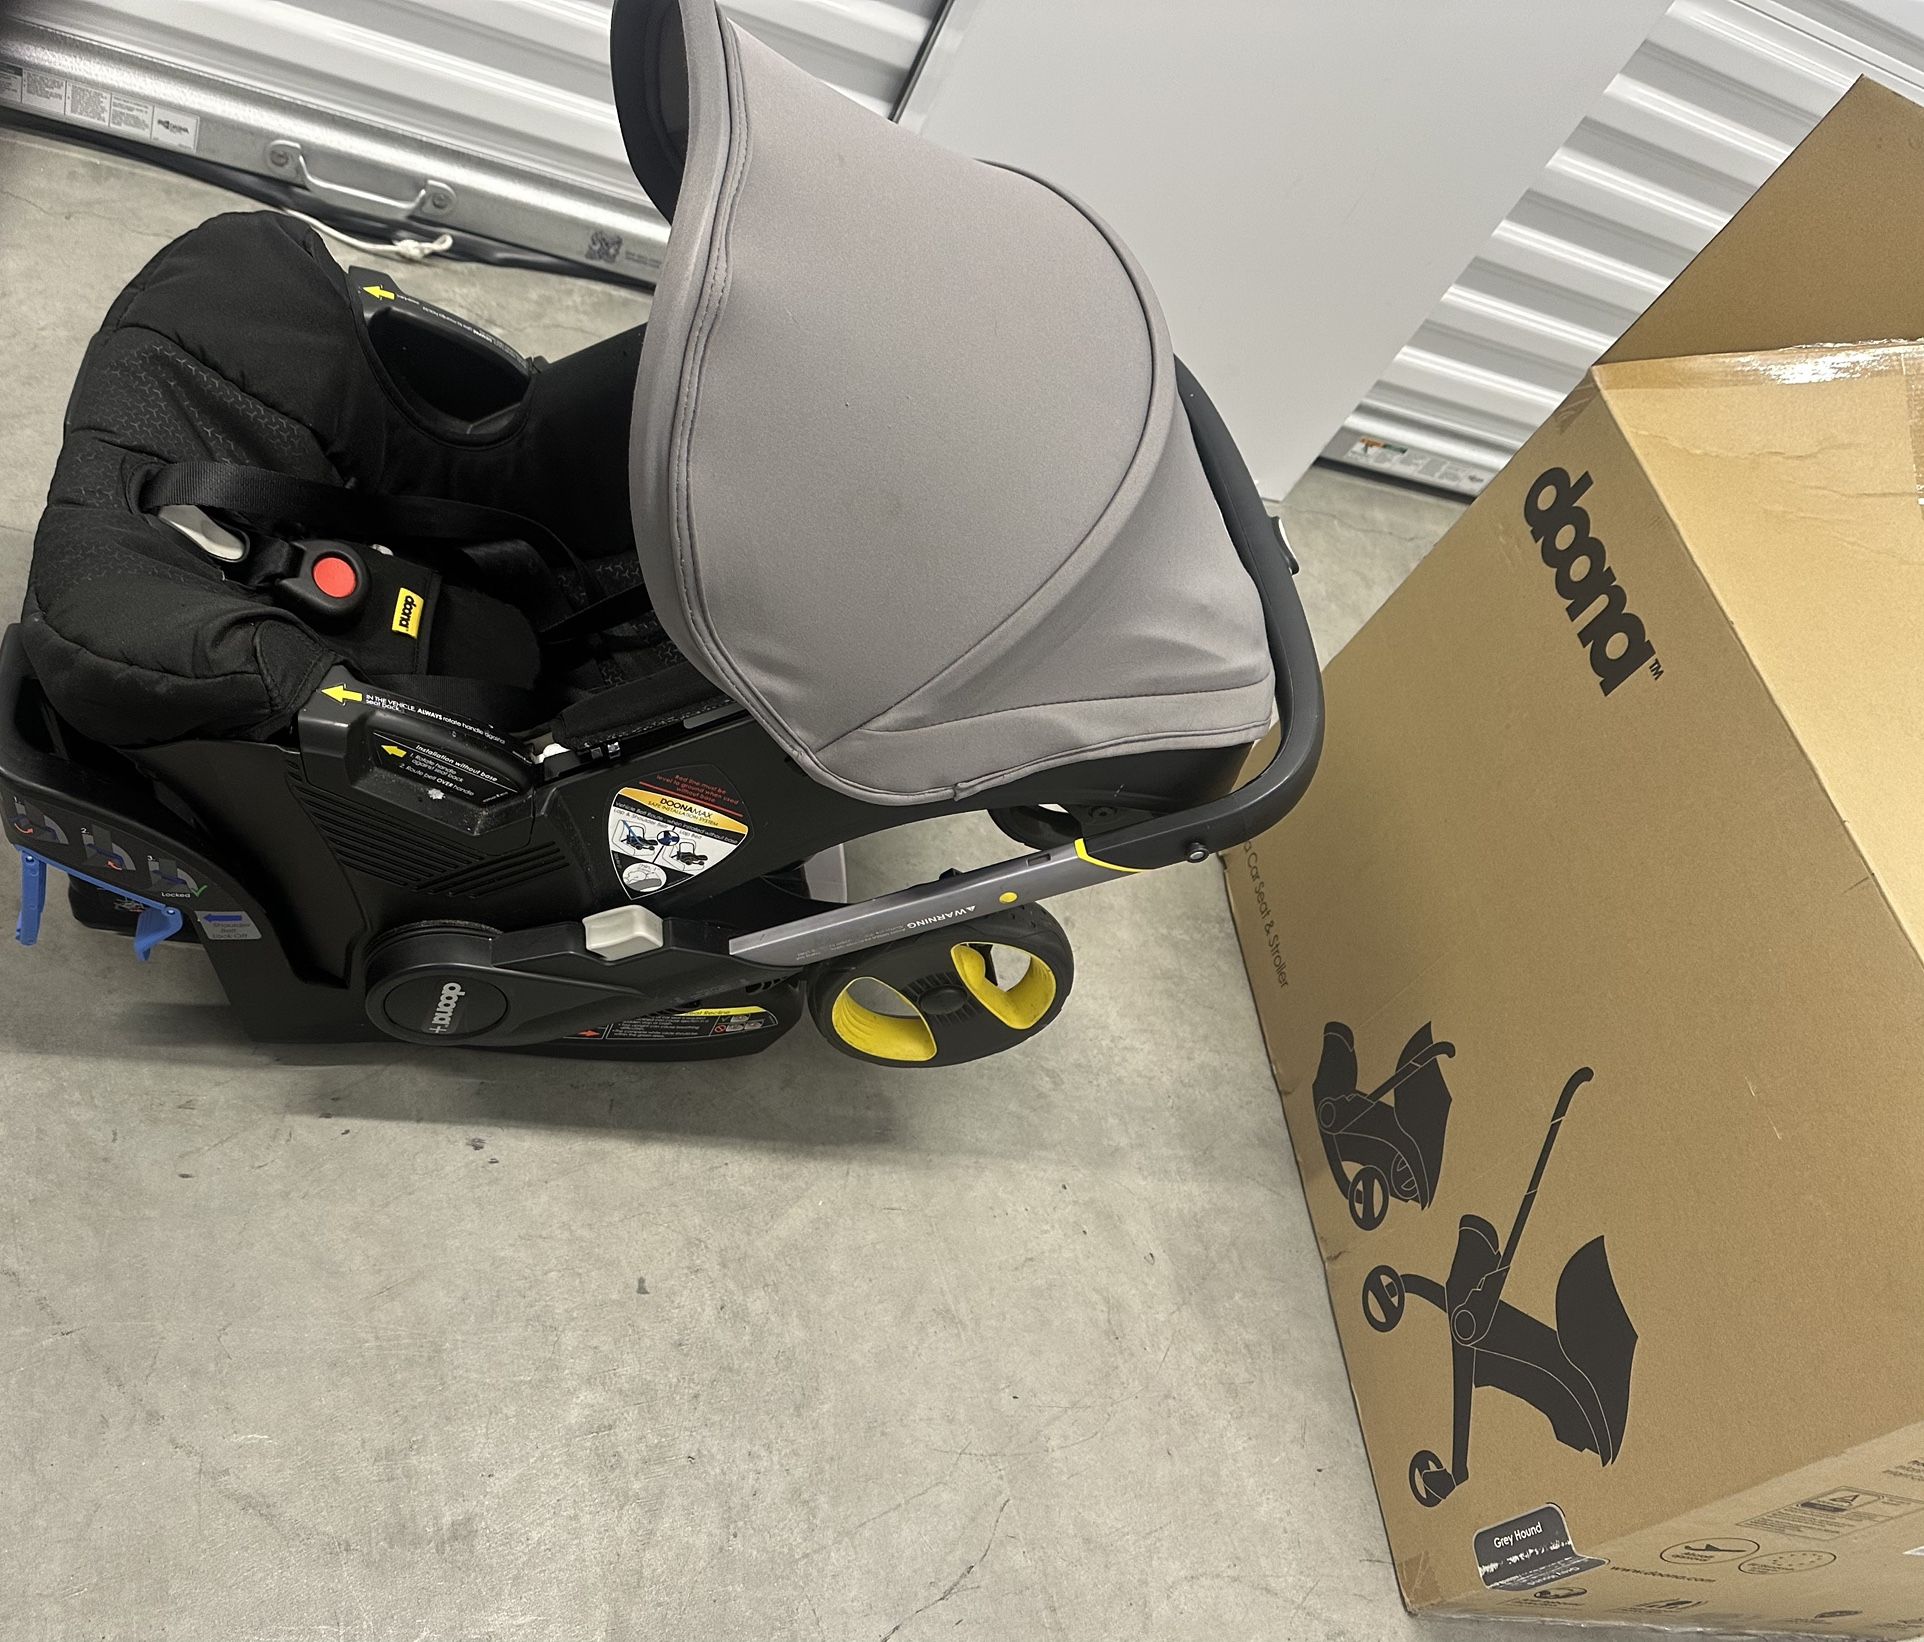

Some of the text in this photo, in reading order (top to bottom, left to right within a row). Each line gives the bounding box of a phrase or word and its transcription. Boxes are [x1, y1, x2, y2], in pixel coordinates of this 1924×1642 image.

[1524, 467, 1656, 697] doona
[399, 595, 417, 628] doona
[375, 695, 387, 704] THE
[417, 708, 442, 719] ALWAYS
[443, 716, 461, 727] rotate
[462, 722, 484, 735] handle
[412, 759, 435, 771] against
[448, 772, 464, 783] back
[415, 755, 435, 766] Rotate
[435, 763, 457, 775] handle
[416, 744, 498, 782] Installation without base
[405, 765, 424, 776] Route
[423, 771, 437, 781] belt
[437, 778, 454, 788] OVER
[453, 784, 475, 796] handle
[660, 797, 714, 819] DOONAMAX
[907, 908, 967, 929] WARNING
[1247, 852, 1260, 881] Car
[1254, 881, 1272, 920] Seat
[1264, 920, 1274, 936] &
[1269, 934, 1289, 989] Stroller
[1494, 1521, 1543, 1548] Grey Hound
